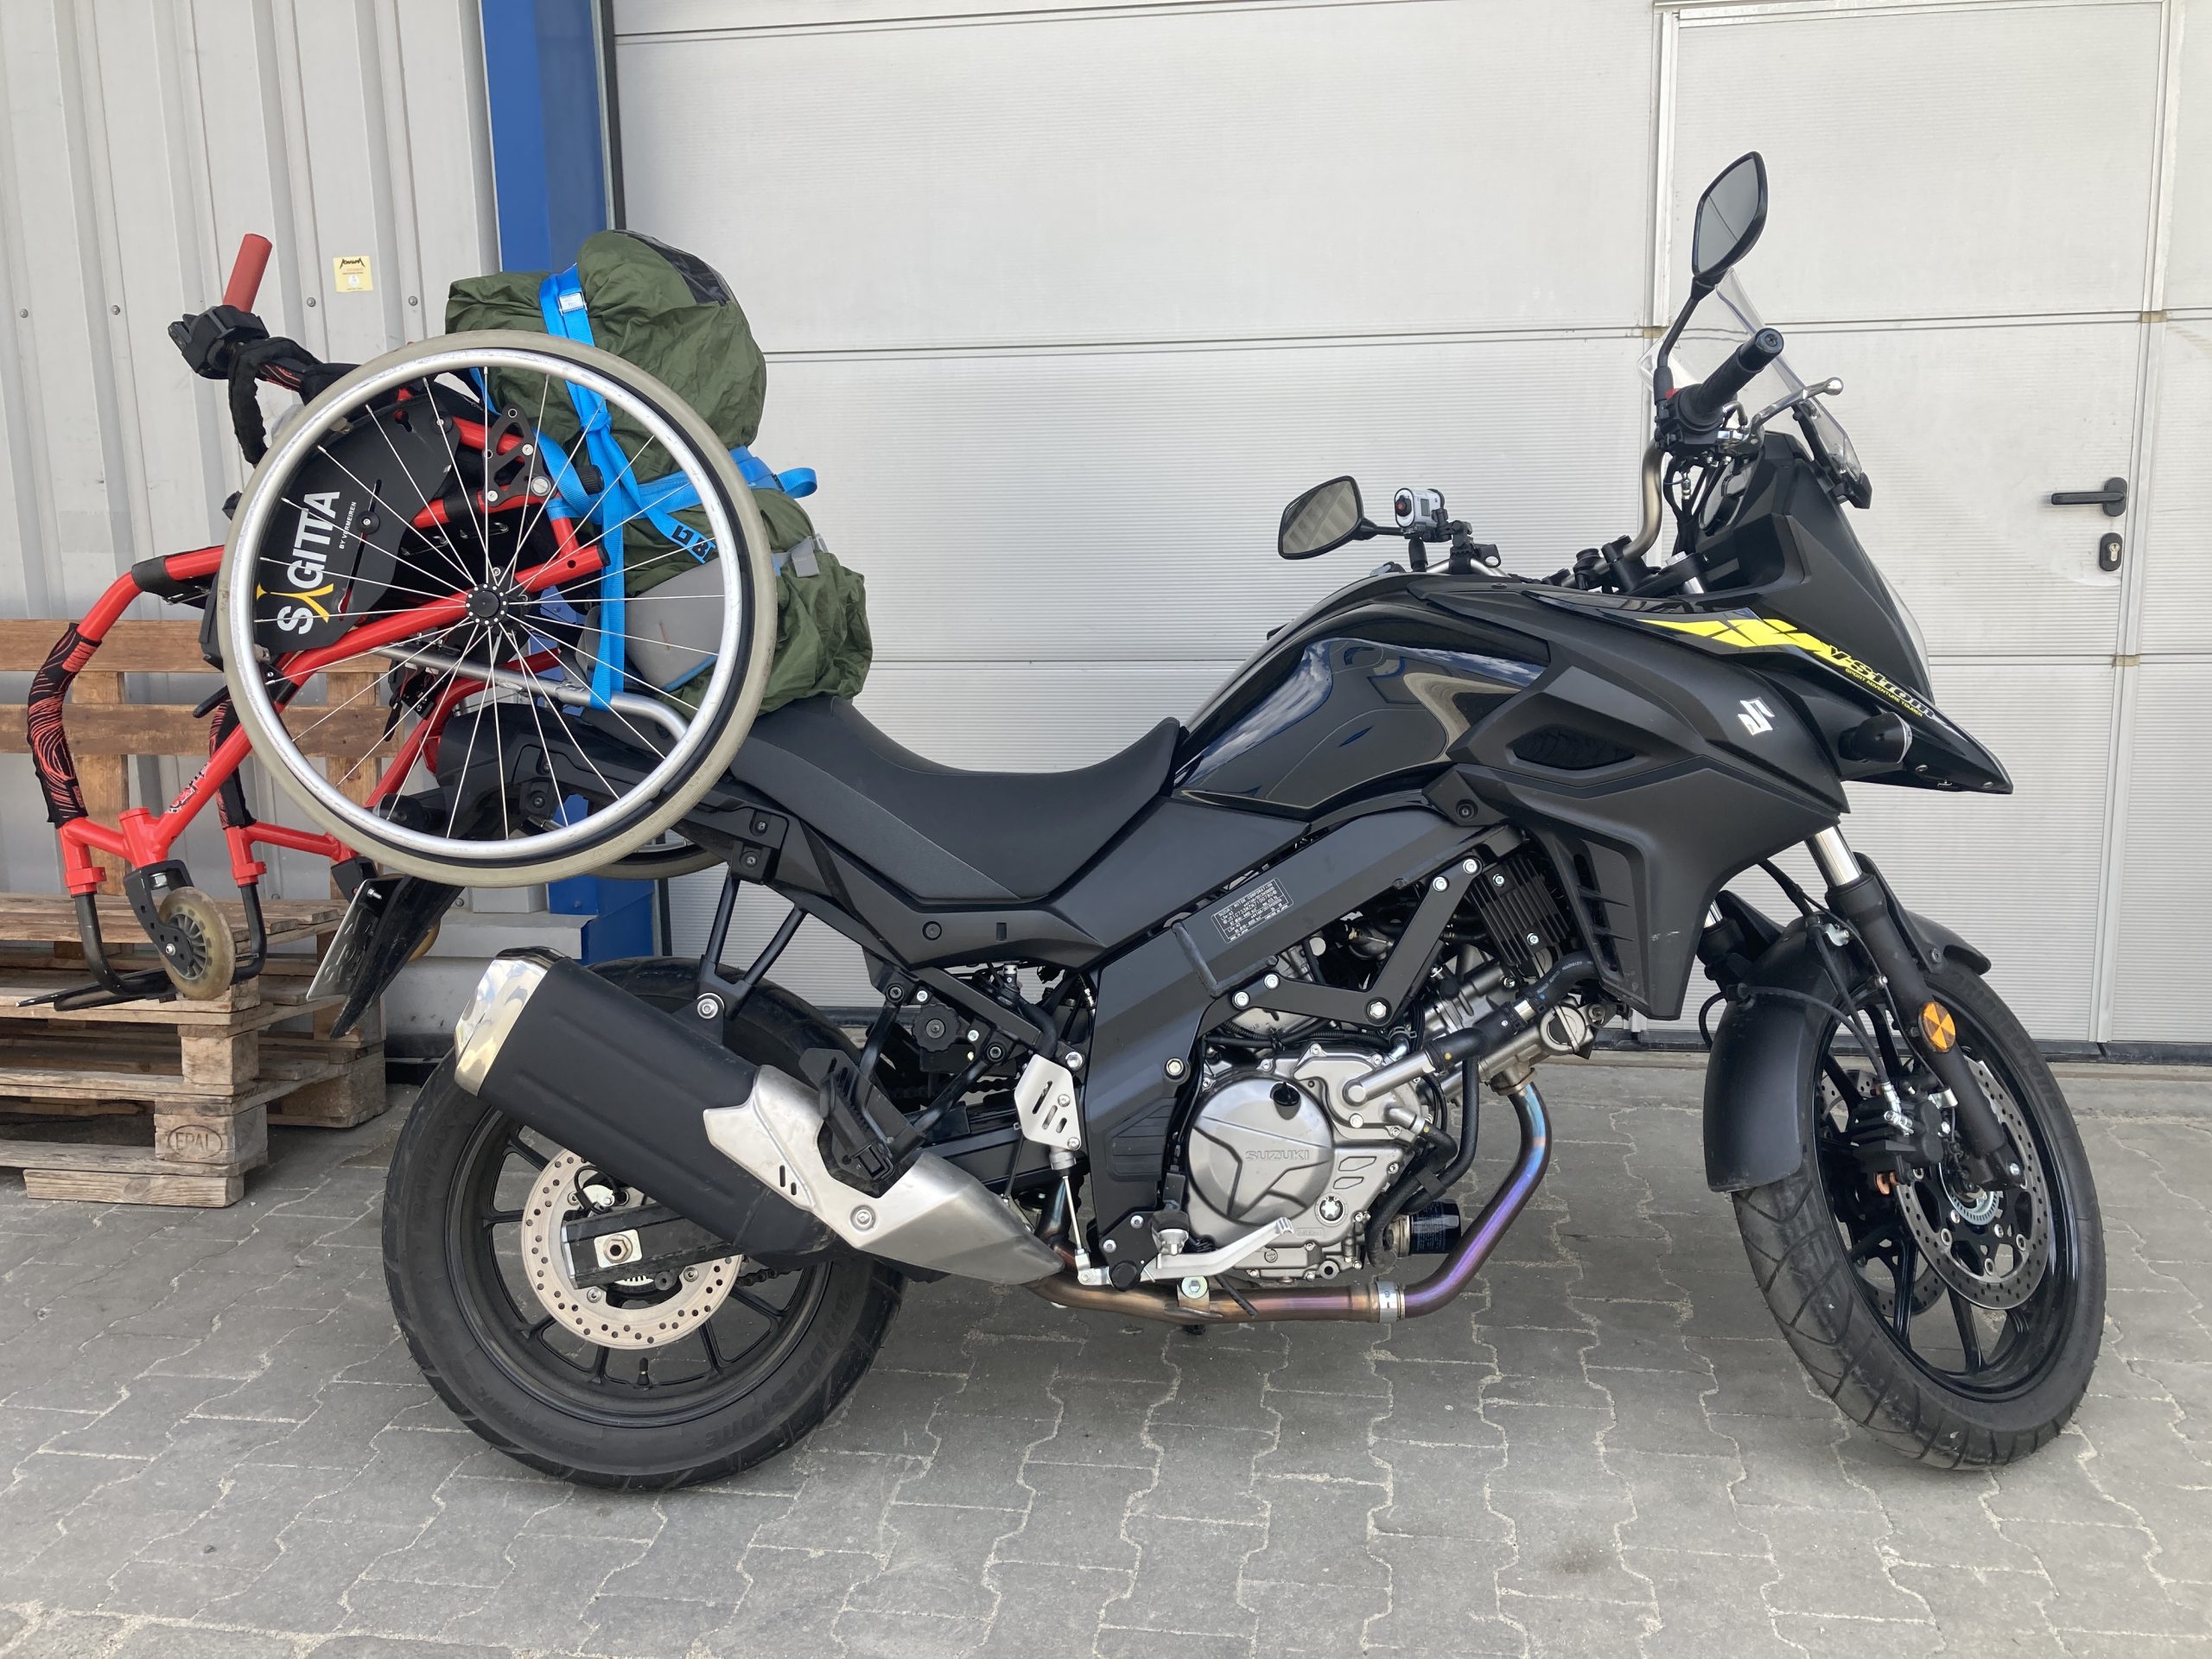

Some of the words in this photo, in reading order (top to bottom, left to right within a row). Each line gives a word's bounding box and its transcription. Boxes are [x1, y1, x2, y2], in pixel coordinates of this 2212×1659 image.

[339, 539, 346, 549] BY
[1845, 668, 1866, 682] SPORT
[1866, 680, 1901, 703] ADVENTURE
[1901, 701, 1923, 717] TOURER
[175, 1133, 212, 1152] EPAL
[1245, 1149, 1310, 1160] SUZUKI
